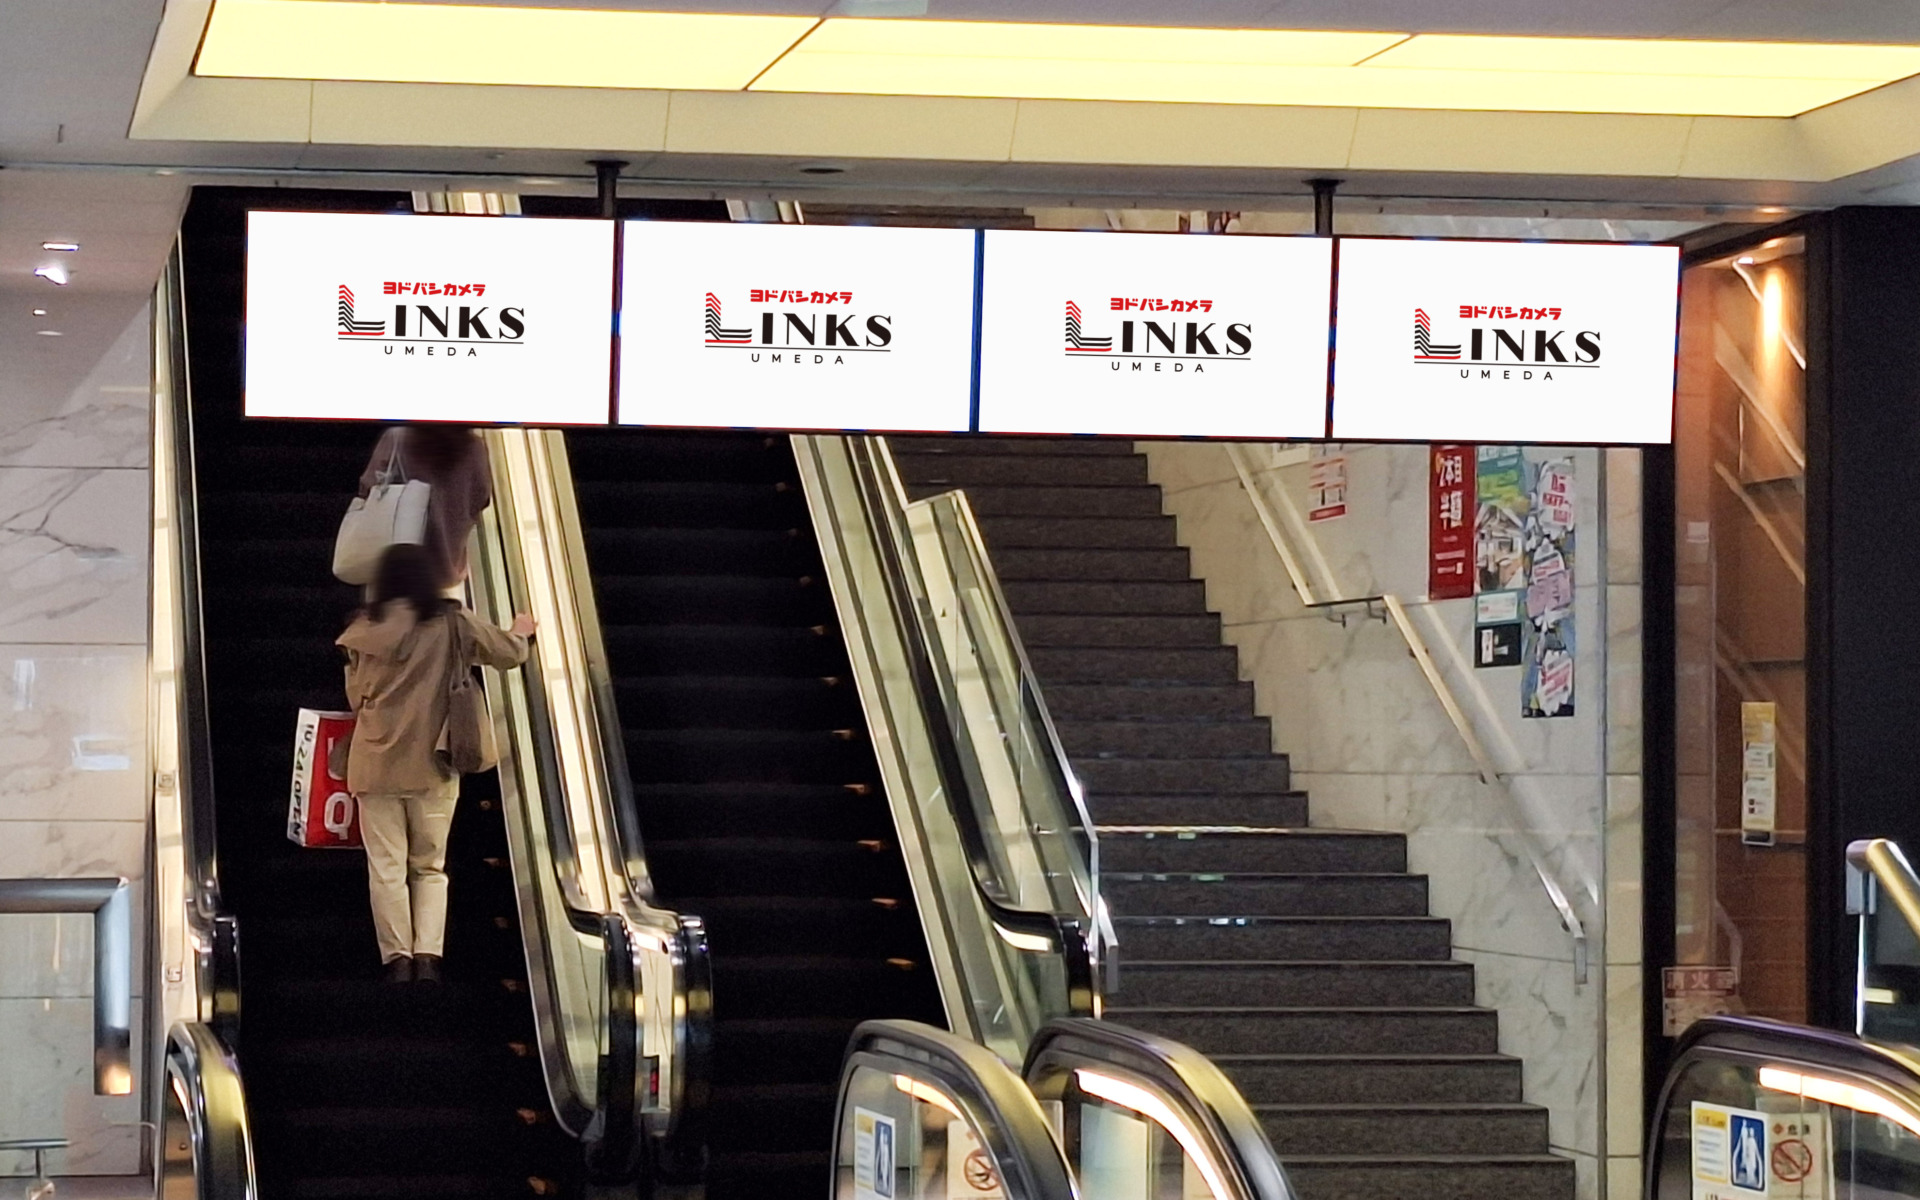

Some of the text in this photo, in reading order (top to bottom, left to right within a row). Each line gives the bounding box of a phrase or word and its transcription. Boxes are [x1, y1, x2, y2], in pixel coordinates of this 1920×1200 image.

[383, 281, 486, 297] ヨドバシカメラ
[750, 289, 853, 305] ヨドバシカメラ
[338, 284, 525, 340] LINKS
[1110, 297, 1213, 313] ヨドバシカメラ
[1459, 305, 1562, 321] ヨドバシカメラ
[705, 292, 892, 348] LINKS
[1065, 300, 1252, 356] LINKS
[1414, 307, 1601, 364] LINKS
[384, 345, 477, 357] UMEDA
[751, 353, 844, 365] UMEDA
[1111, 361, 1204, 373] UMEDA
[1460, 369, 1553, 381] UMEDA
